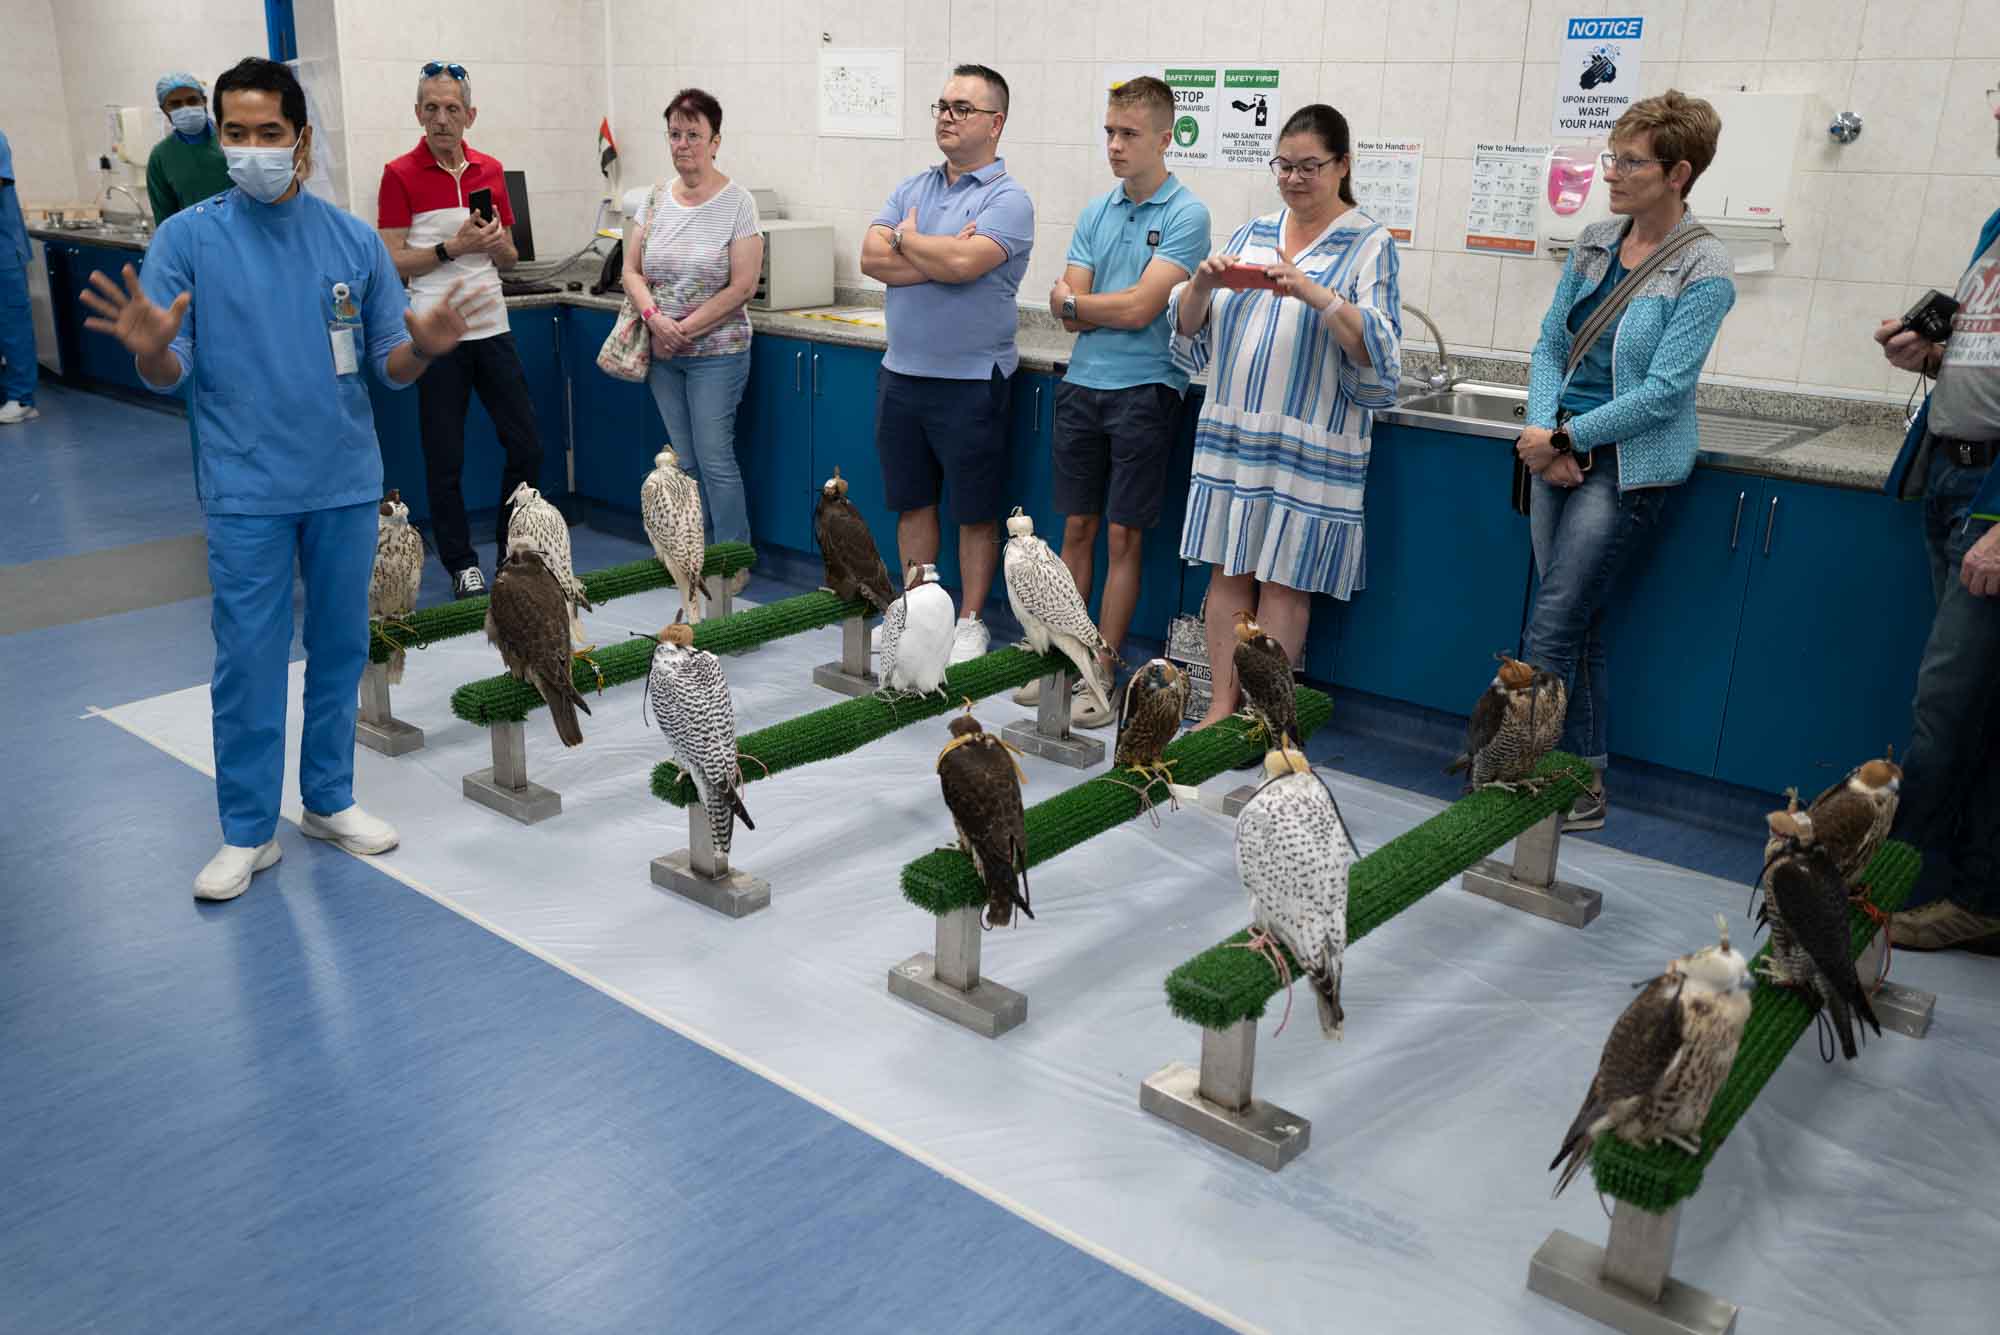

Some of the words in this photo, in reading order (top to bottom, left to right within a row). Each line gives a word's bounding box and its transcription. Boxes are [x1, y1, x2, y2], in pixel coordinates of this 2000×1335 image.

[1570, 20, 1641, 37] NOTICE
[1193, 74, 1215, 82] FIRST
[1255, 75, 1277, 83] FIRST
[1174, 91, 1204, 103] STOP
[1562, 95, 1586, 104] UPON
[1587, 95, 1629, 105] ENTERING
[1174, 104, 1210, 112] RONAVIRUS
[1578, 107, 1610, 117] WASH
[1560, 119, 1587, 129] YOUR
[1588, 119, 1617, 129] HAND
[1222, 132, 1240, 140] HAND
[1240, 132, 1273, 141] SANITIZER
[1233, 139, 1260, 147] STATION
[1357, 141, 1374, 150] How
[1376, 142, 1383, 150] to
[1477, 143, 1494, 151] How
[1496, 143, 1504, 152] to
[1183, 151, 1188, 159] A
[1247, 149, 1271, 157] SPREAD
[1236, 156, 1263, 164] COVID-19
